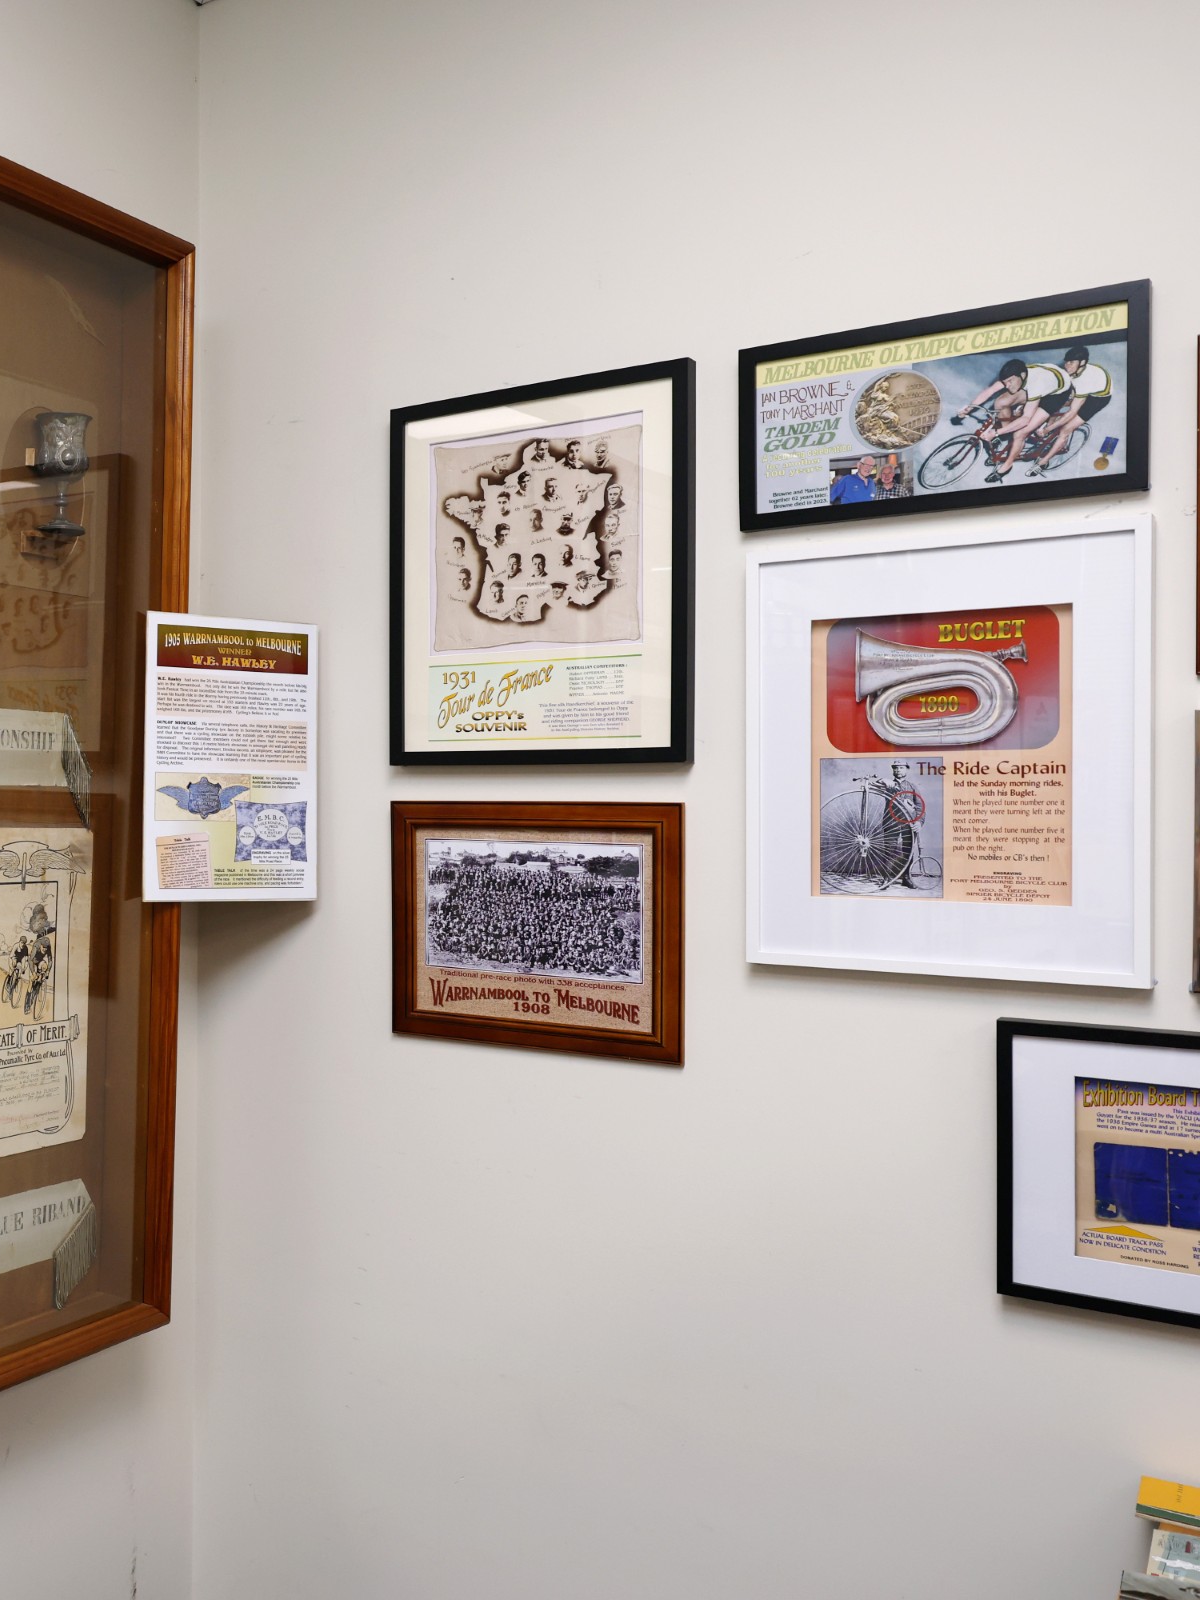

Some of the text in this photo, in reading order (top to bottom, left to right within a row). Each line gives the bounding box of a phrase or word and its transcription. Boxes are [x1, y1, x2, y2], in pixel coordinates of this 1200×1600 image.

[762, 308, 1116, 386] MELBOURNE OLYMPIC CELEBRATION
[761, 380, 855, 407] IAN BROWNE &
[760, 399, 845, 423] TONY MARCHANT
[765, 417, 842, 439] TANDEM
[763, 431, 836, 453] GOLD
[938, 619, 1026, 643] BUGLET
[164, 632, 302, 656] 1905 WARRNAMBOOL to MELBOURNE
[218, 647, 252, 656] WINNER
[192, 655, 277, 670] W.E. HAWLEY
[442, 671, 476, 690] 1931
[437, 692, 475, 729] Tour
[477, 680, 495, 707] de
[497, 664, 554, 707] France
[919, 695, 960, 713] 1890
[471, 710, 525, 721] OPPY's
[456, 722, 528, 733] SOUVENIR
[916, 760, 1067, 779] The Ride Captain
[980, 780, 1007, 788] Sunday
[1009, 780, 1040, 788] morning
[979, 789, 995, 797] with
[1010, 789, 1037, 798] Buglet.
[982, 799, 1002, 807] played
[1030, 854, 1045, 862] then
[440, 969, 478, 979] Traditional
[480, 973, 512, 983] pre-race
[514, 976, 537, 985] photo
[538, 976, 555, 985] with
[574, 980, 627, 992] acceptances.
[429, 977, 641, 1026] WARRNAMBOOL TO MELBOURNE
[513, 1001, 550, 1015] 1908
[26, 1029, 38, 1043] OF
[1083, 1080, 1144, 1107] Exhibition
[1148, 1086, 1187, 1106] Board
[1082, 1232, 1104, 1240] ACTUAL
[1106, 1235, 1127, 1243] BOARD
[1129, 1238, 1148, 1246] TRACK
[1104, 1242, 1130, 1251] DELICATE
[1132, 1246, 1167, 1256] CONDITION
